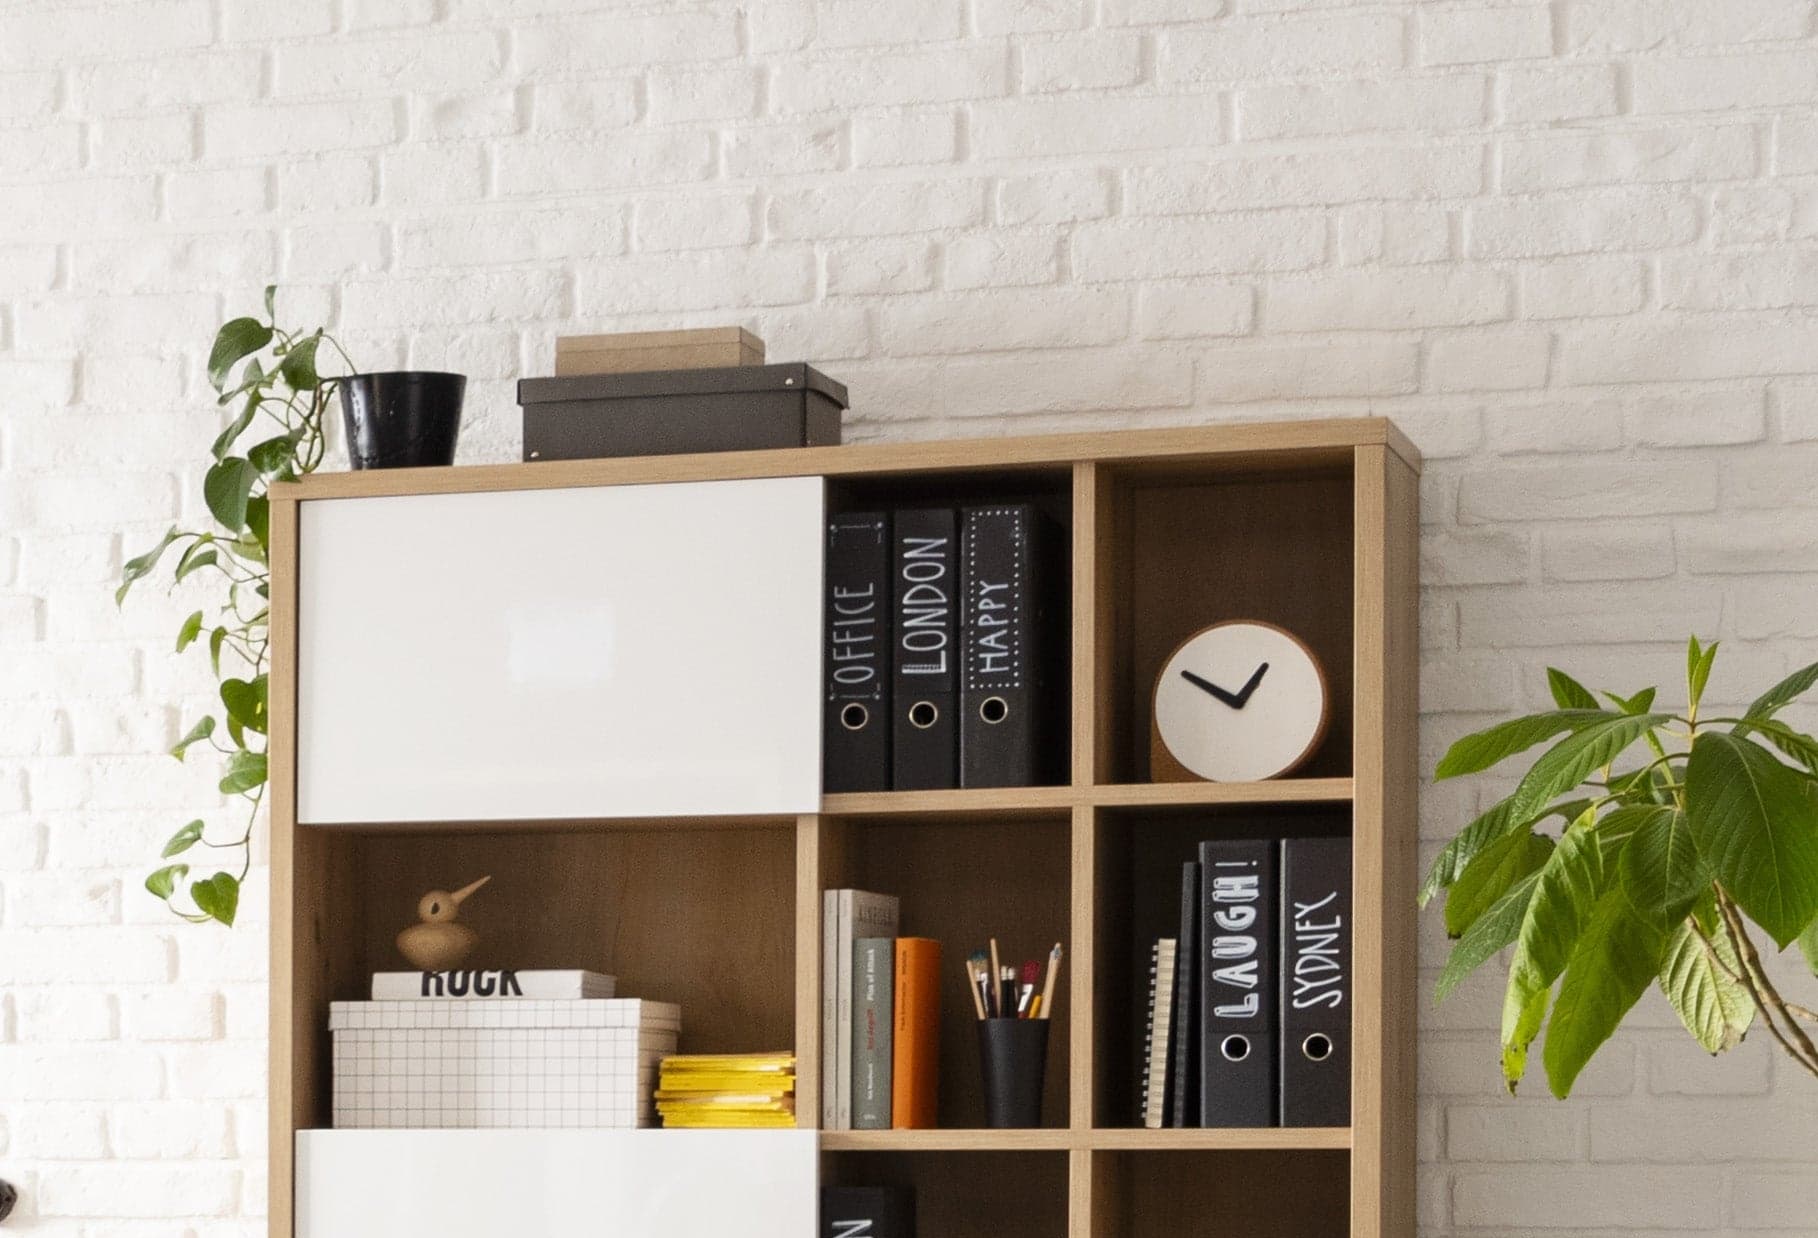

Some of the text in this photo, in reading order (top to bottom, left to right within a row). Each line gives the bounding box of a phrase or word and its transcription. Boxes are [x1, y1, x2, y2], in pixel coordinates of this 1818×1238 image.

[833, 582, 874, 683] OFFICE
[902, 538, 948, 674] LONDON
[978, 580, 1010, 673] HAPPY
[1212, 860, 1260, 1018] LAUGH!
[1292, 891, 1342, 1008] SYDNEY
